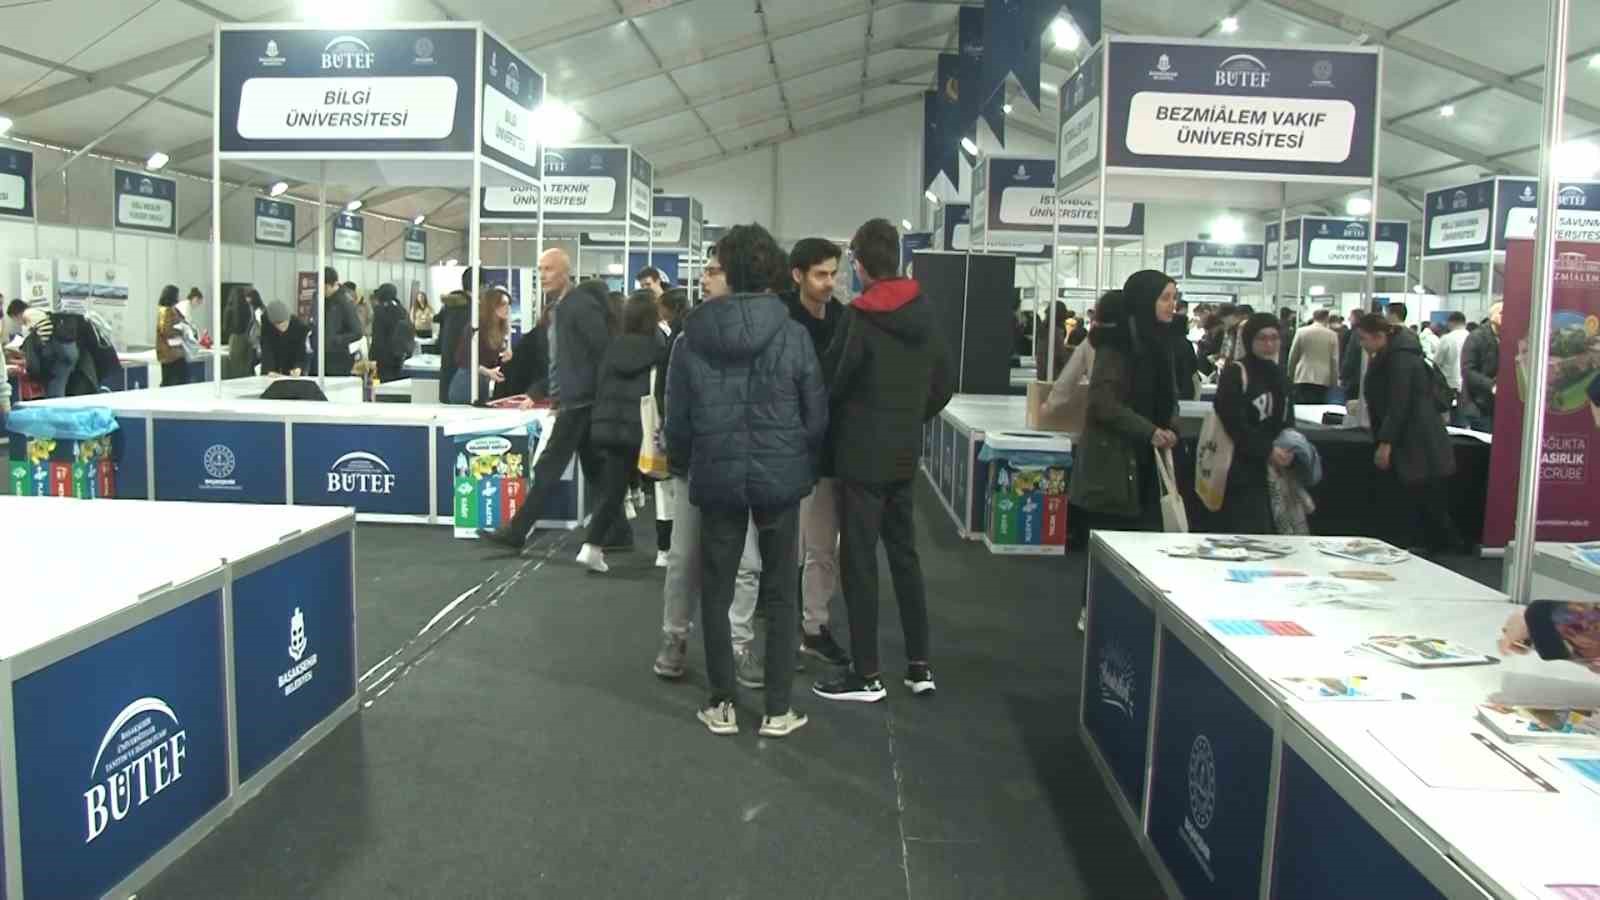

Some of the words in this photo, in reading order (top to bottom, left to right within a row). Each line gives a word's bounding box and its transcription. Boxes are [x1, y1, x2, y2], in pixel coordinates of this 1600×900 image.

[324, 87, 372, 105] BİLGİ
[286, 109, 409, 127] ÜNİVERSİTESİ
[1272, 110, 1327, 127] VAKIF
[1177, 128, 1305, 149] ÜNİVERSİTESİ
[551, 181, 590, 193] TEKNİK
